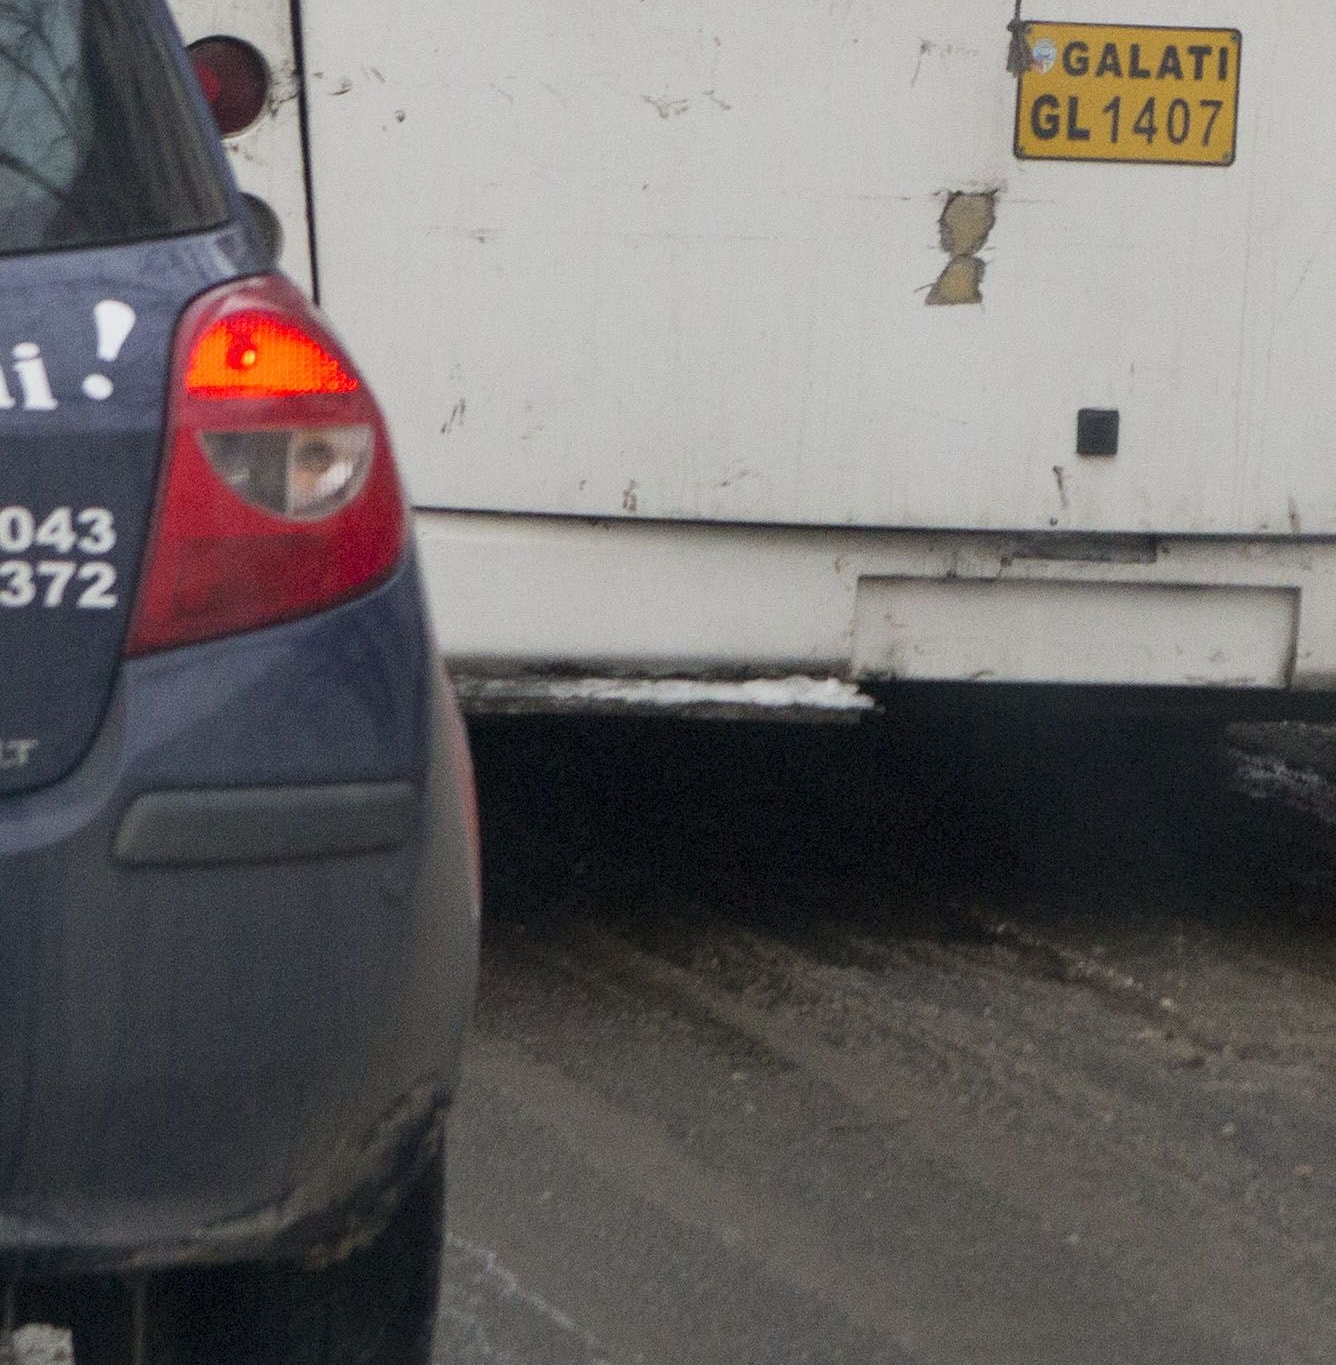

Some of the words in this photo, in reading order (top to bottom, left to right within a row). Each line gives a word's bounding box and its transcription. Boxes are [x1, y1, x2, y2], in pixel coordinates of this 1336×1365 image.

[1061, 40, 1229, 81] GALATI
[1030, 92, 1091, 141] GL
[1102, 95, 1224, 147] 1407
